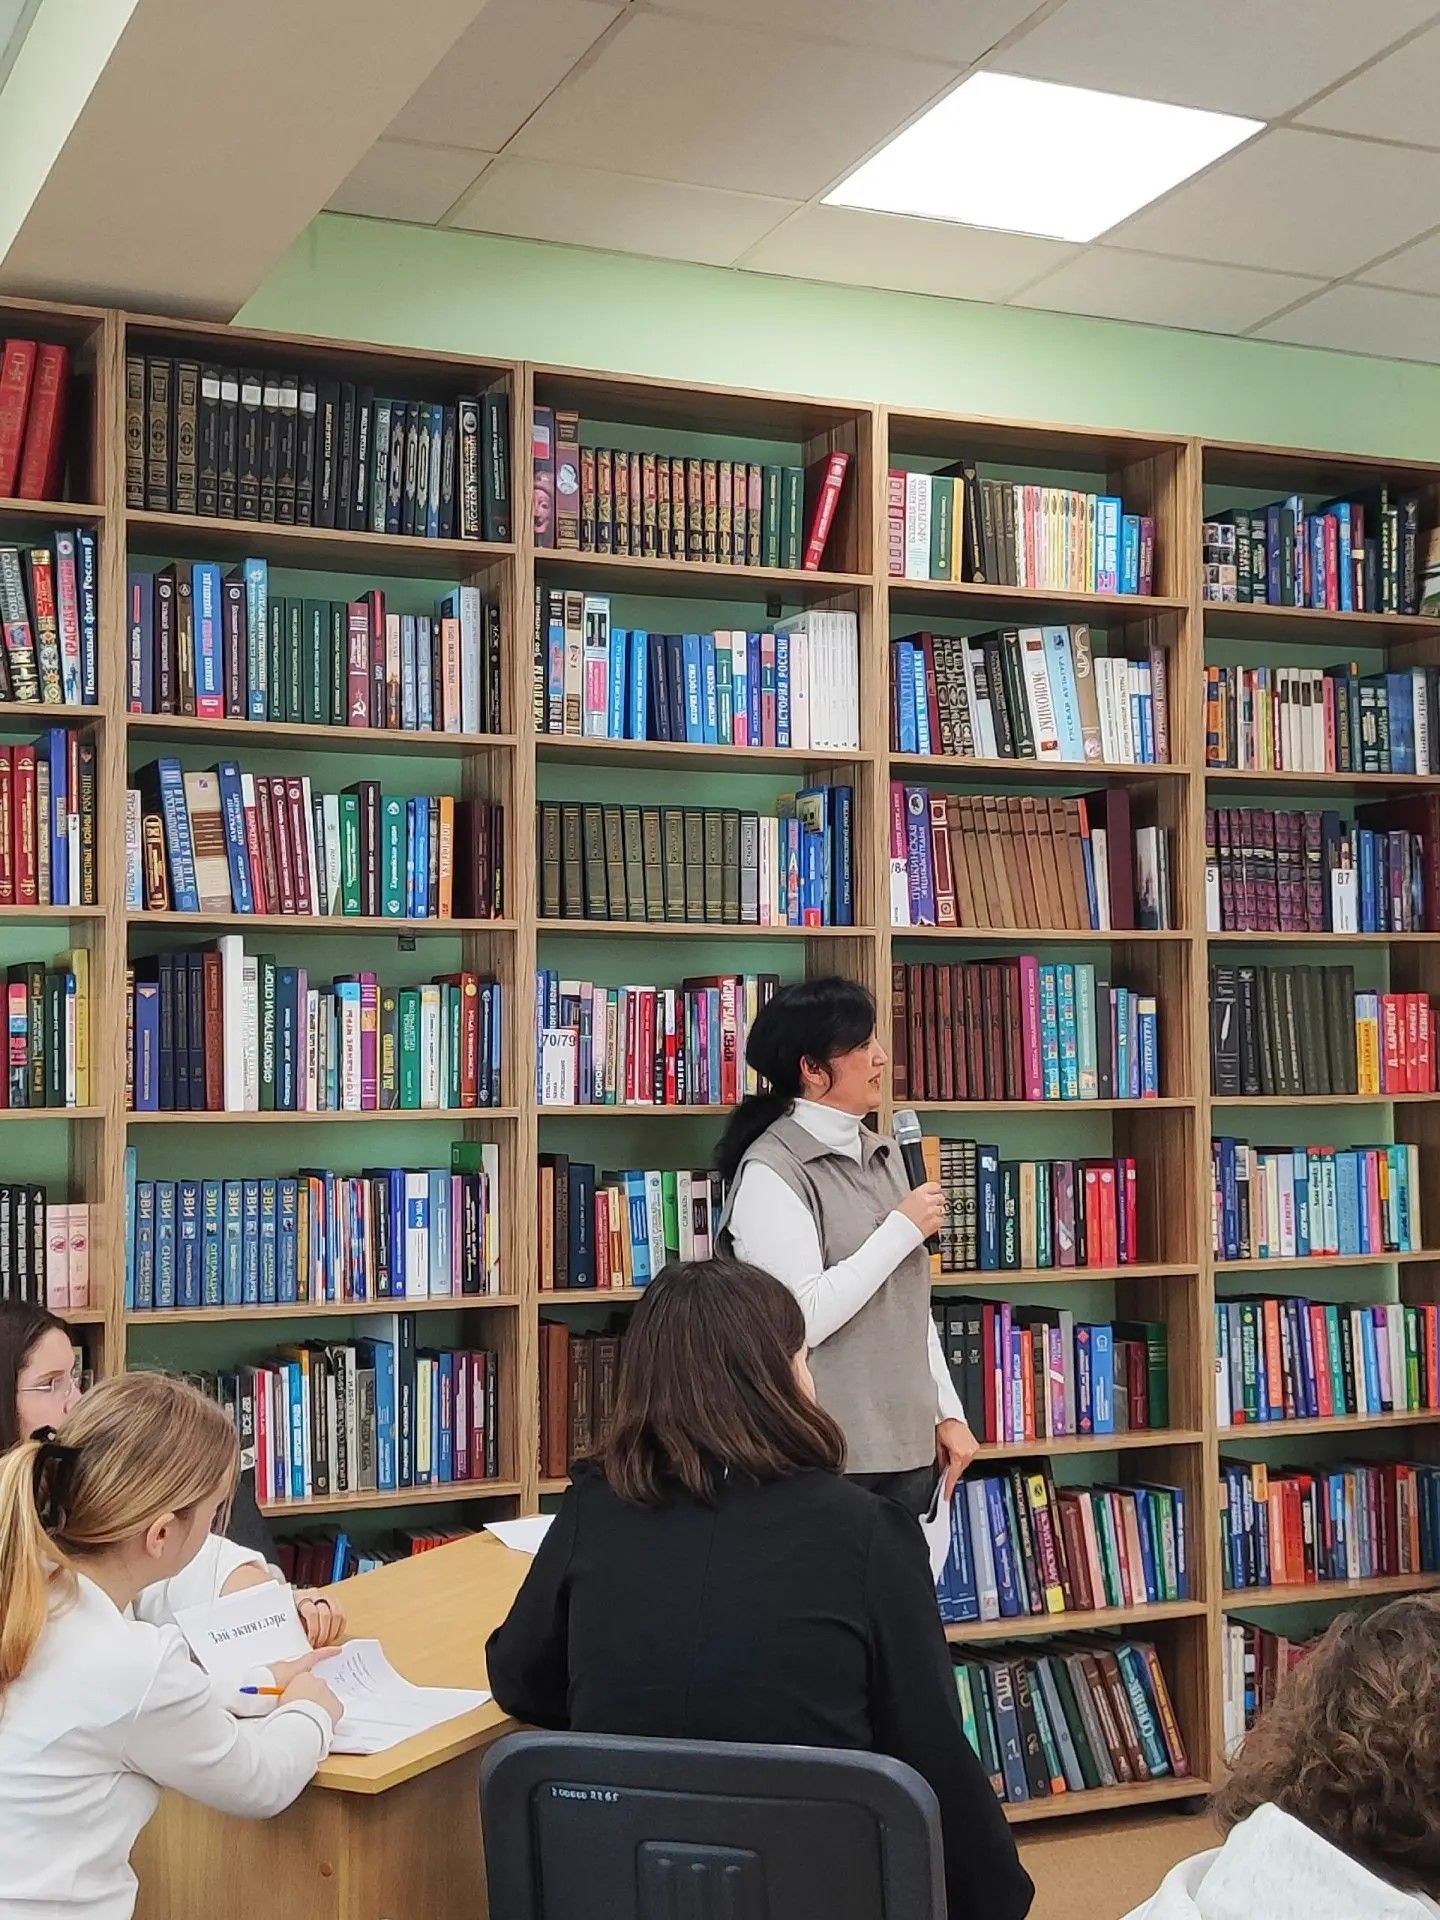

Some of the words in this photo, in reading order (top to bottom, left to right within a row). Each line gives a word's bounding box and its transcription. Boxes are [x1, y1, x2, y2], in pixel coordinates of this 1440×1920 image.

[63, 604, 80, 657] КРАСНАЯ
[777, 638, 788, 678] РОССИИ
[777, 681, 789, 728] ИСТОРИЯ
[1032, 671, 1054, 733] ЭКОНОМИКС
[81, 773, 93, 812] РОССИИ
[175, 788, 196, 892] ЭНЦИКЛОПЕДИЯ
[909, 824, 920, 900] ПУШКИНСКАЯ
[171, 857, 184, 893] БОЛЬШАЯ
[1337, 872, 1350, 886] 87
[264, 963, 275, 999] СПОРТ
[346, 1009, 354, 1036] ИГРЫ
[541, 1034, 577, 1047] 70/79
[1143, 1015, 1153, 1073] ЛИТЕРАТУРА
[1386, 1002, 1398, 1050] КАРНЕГИ
[263, 1009, 274, 1083] ФИЗКУЛЬТУРА
[723, 1029, 735, 1062] КРЕСТ
[594, 1057, 604, 1098] ОСНОВЫ
[1005, 1217, 1016, 1264] СЛОВАРЬ
